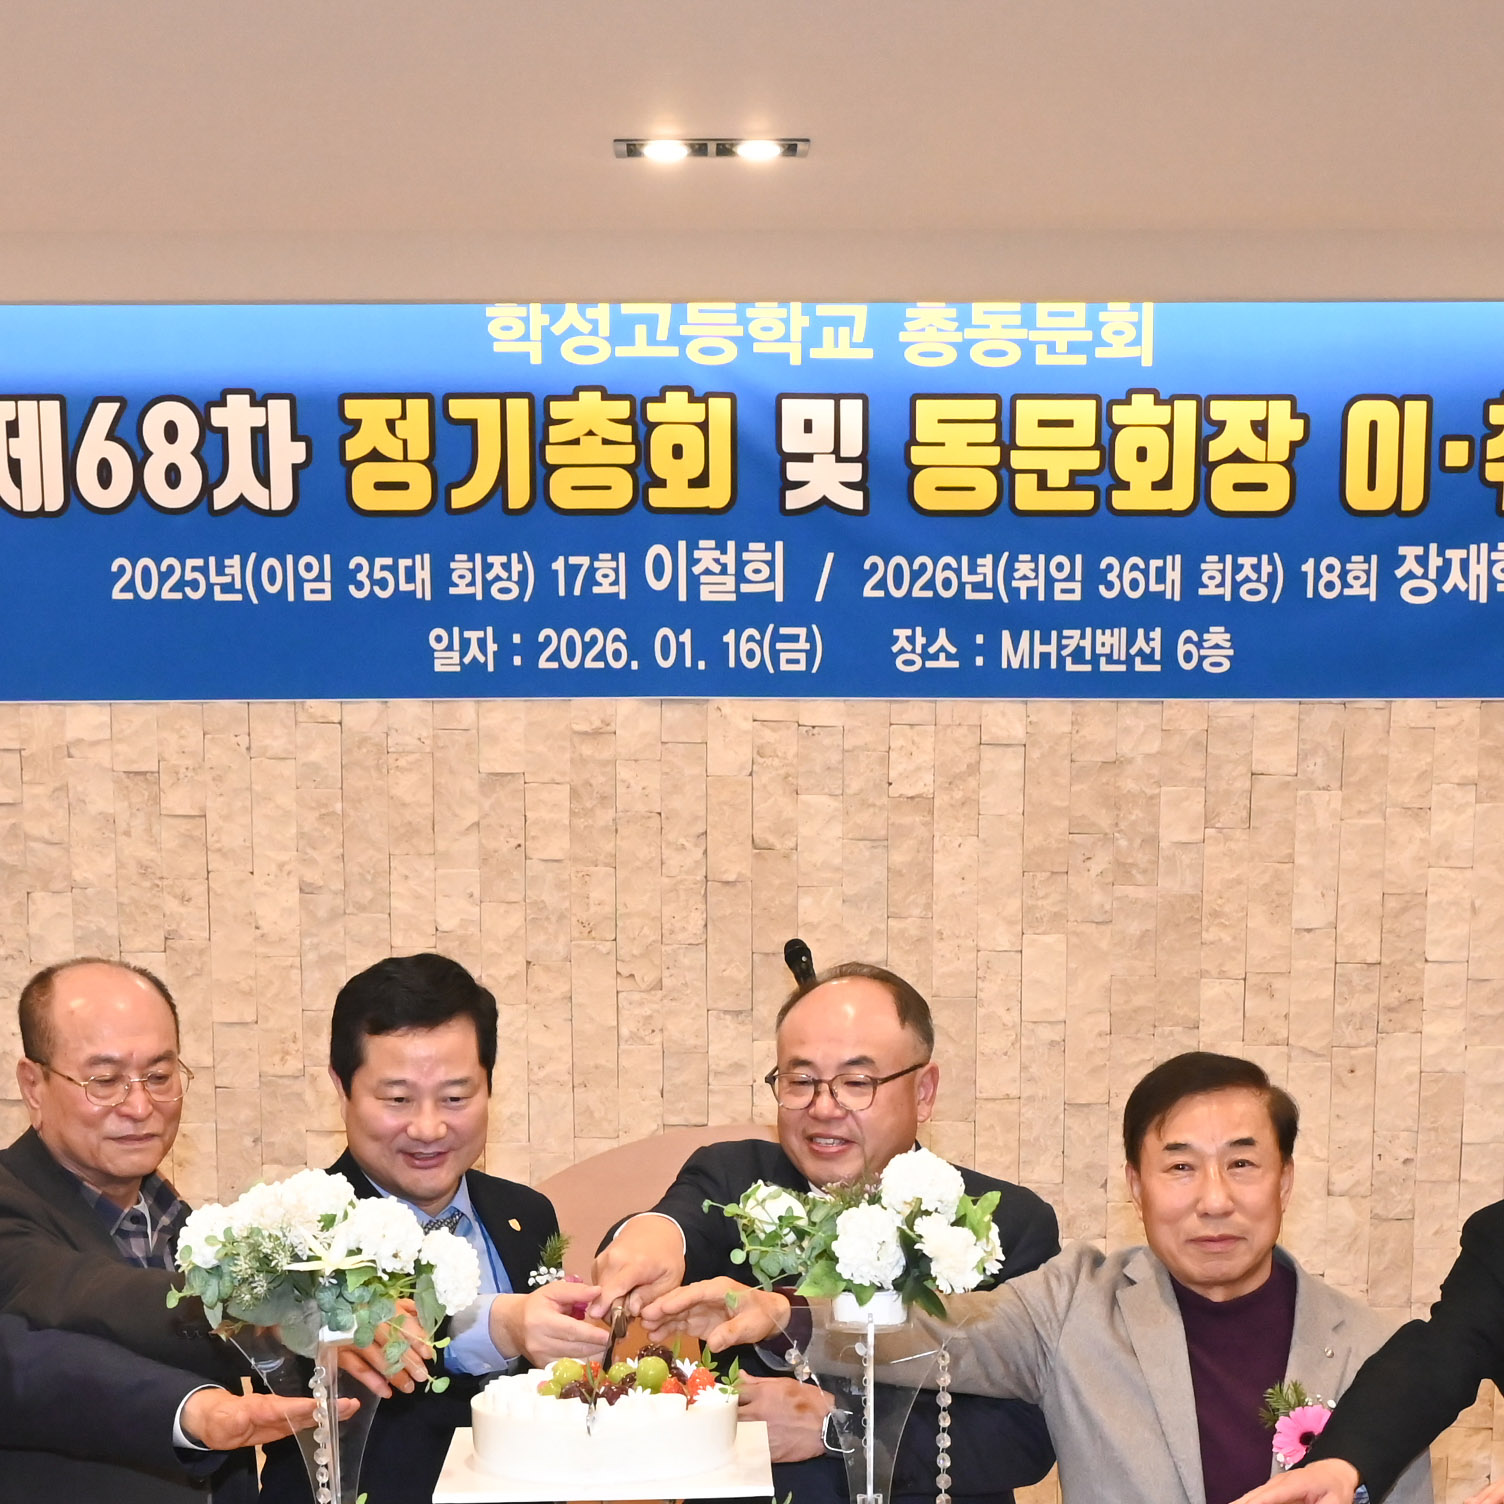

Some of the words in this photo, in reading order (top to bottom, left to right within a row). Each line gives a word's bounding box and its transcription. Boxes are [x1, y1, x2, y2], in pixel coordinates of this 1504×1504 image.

[485, 303, 874, 366] 학성고등학교
[898, 303, 1155, 368] 총동문회
[340, 386, 738, 517] 정기총회
[777, 393, 870, 516] 및
[906, 389, 1310, 518] 동문회장
[111, 551, 331, 605] 2025년(이임
[349, 553, 431, 601] 35대
[449, 550, 535, 602] 회장)
[552, 551, 627, 600] 17회
[645, 539, 784, 602] 이철희
[863, 551, 1082, 604] 2026년(취임
[1099, 554, 1182, 602] 36대
[1199, 552, 1283, 603] 회장)
[1302, 554, 1377, 602] 18회
[429, 626, 497, 672] 일자
[538, 627, 639, 670] 2026.
[654, 627, 706, 670] 01.
[723, 624, 823, 674] 16(금)
[891, 626, 959, 672] 장소
[1002, 626, 1162, 672] MH컨벤션
[1178, 626, 1234, 673] 6층
